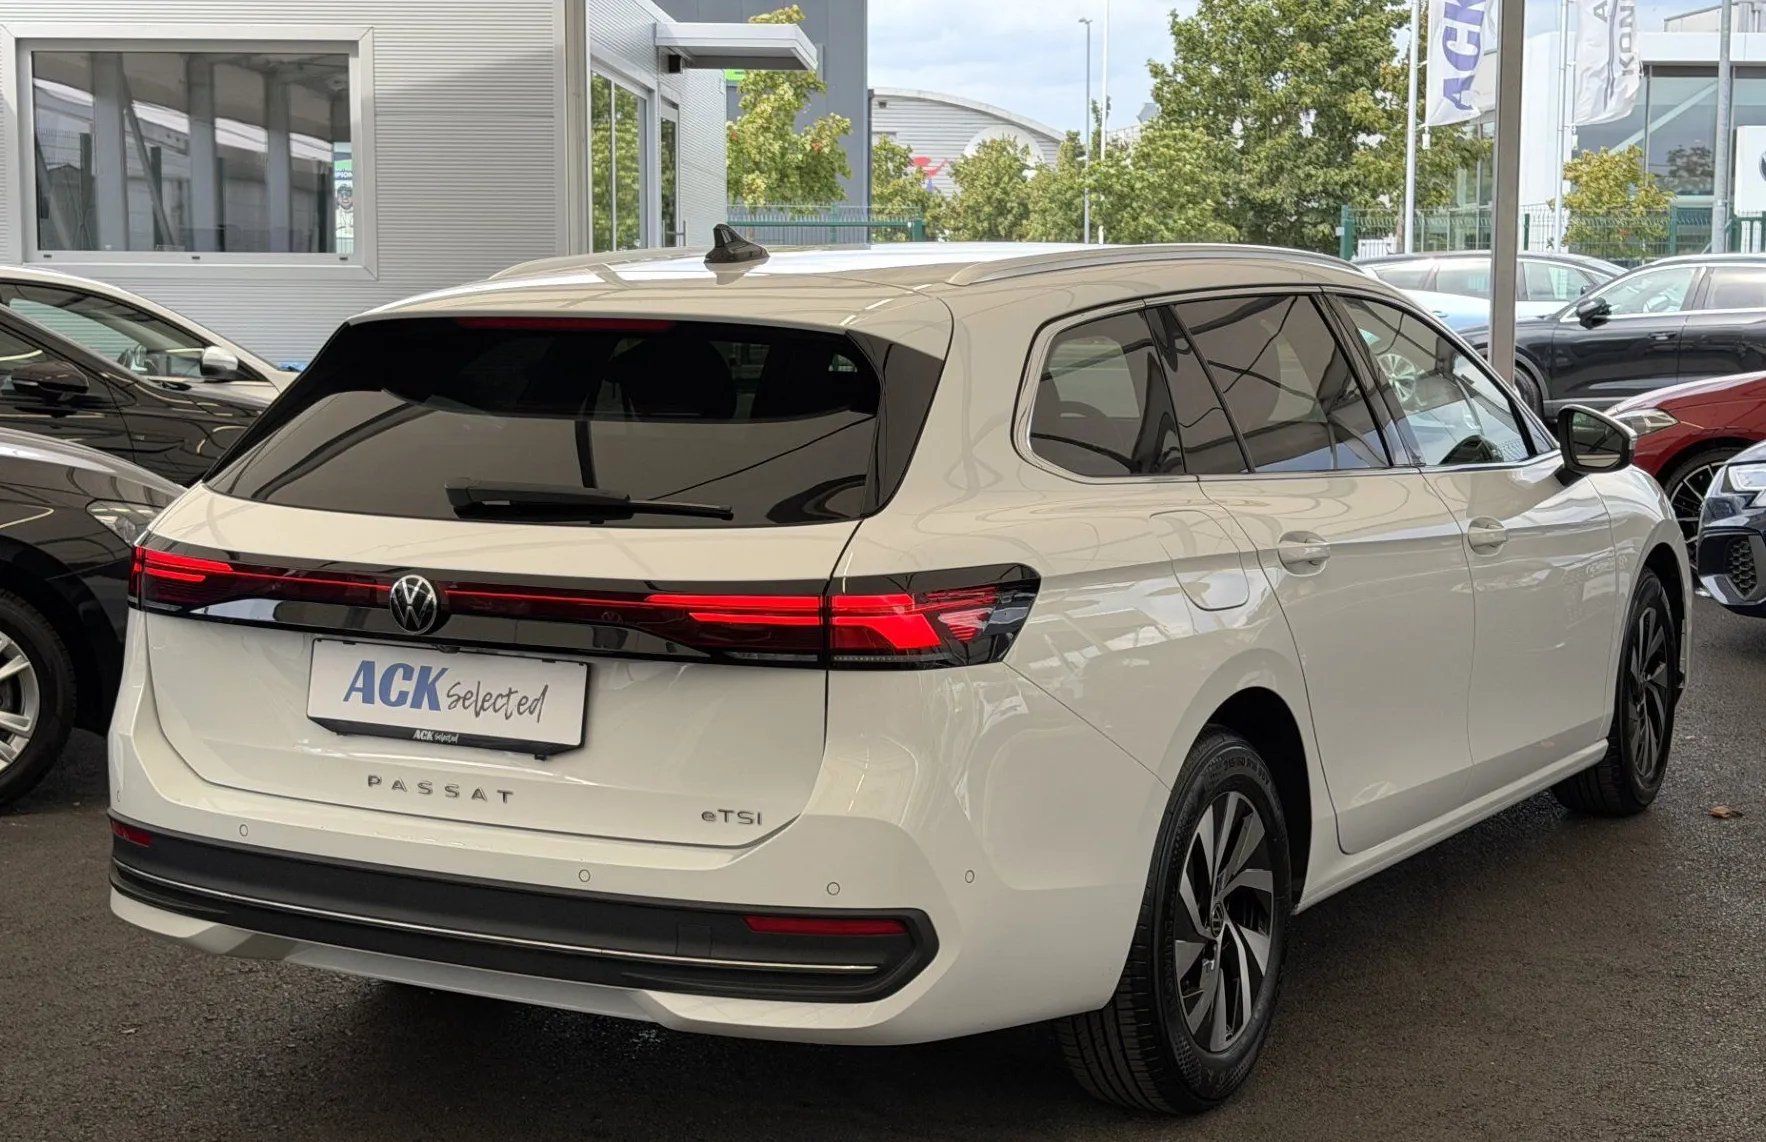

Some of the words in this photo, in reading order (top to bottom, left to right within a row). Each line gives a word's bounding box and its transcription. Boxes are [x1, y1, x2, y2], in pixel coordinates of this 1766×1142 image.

[343, 660, 449, 711] ACK
[446, 681, 549, 723] Selected
[412, 729, 434, 741] ACK
[367, 774, 514, 804] PASSAT
[701, 808, 763, 826] eTSI
